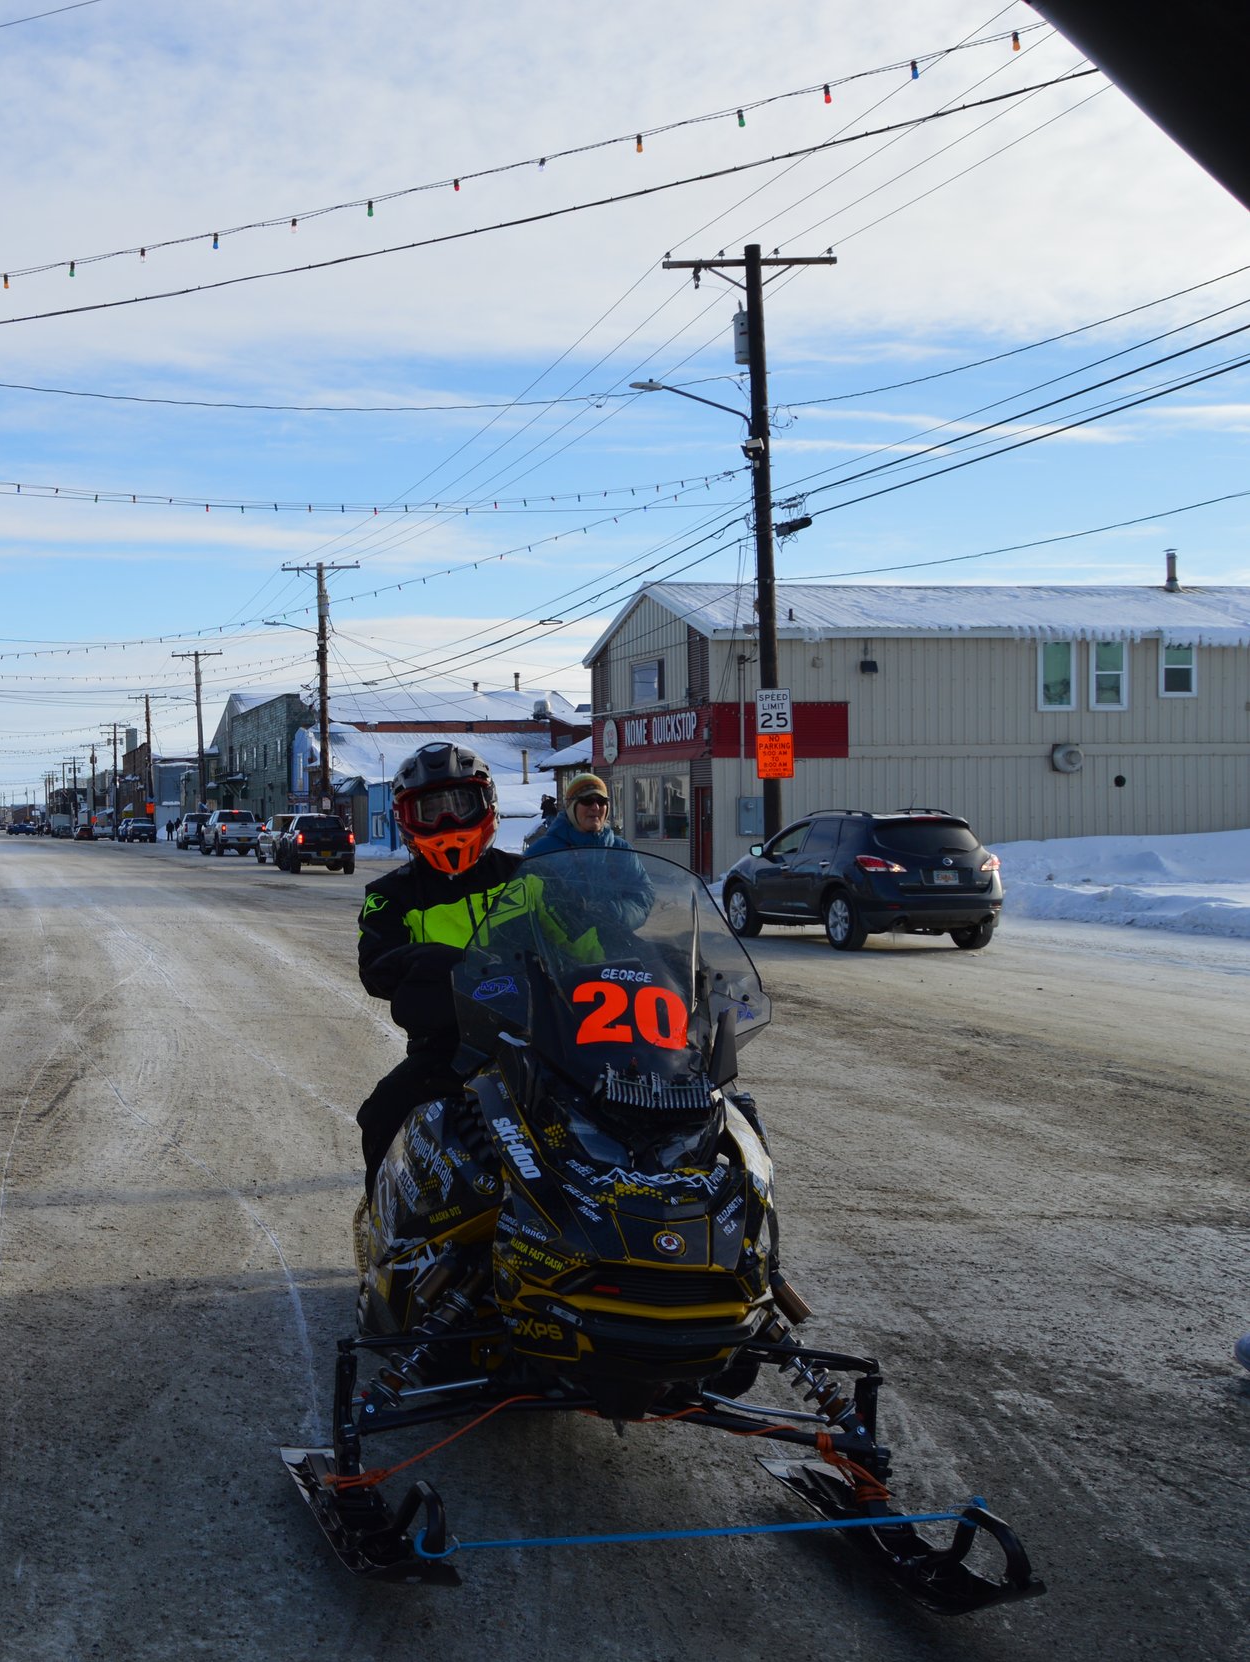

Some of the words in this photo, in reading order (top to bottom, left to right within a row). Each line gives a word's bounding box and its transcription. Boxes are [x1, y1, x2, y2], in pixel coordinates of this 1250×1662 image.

[759, 693, 788, 702] SPEED
[762, 703, 785, 711] LIMIT
[625, 718, 648, 746] NOME
[652, 711, 697, 745] QUICKSTOP
[760, 712, 789, 729] 25
[759, 742, 791, 750] PARKING
[600, 968, 653, 984] GEORGE
[572, 980, 689, 1050] 20
[492, 1117, 541, 1179] ski-doo
[562, 1184, 600, 1208] CHELSEA
[716, 1195, 744, 1224] ELIZABETH
[521, 1224, 547, 1241] VanGo
[722, 1220, 738, 1236] ISLA
[528, 1247, 545, 1262] FAST
[545, 1255, 564, 1271] CASH
[514, 1317, 564, 1341] XPS
